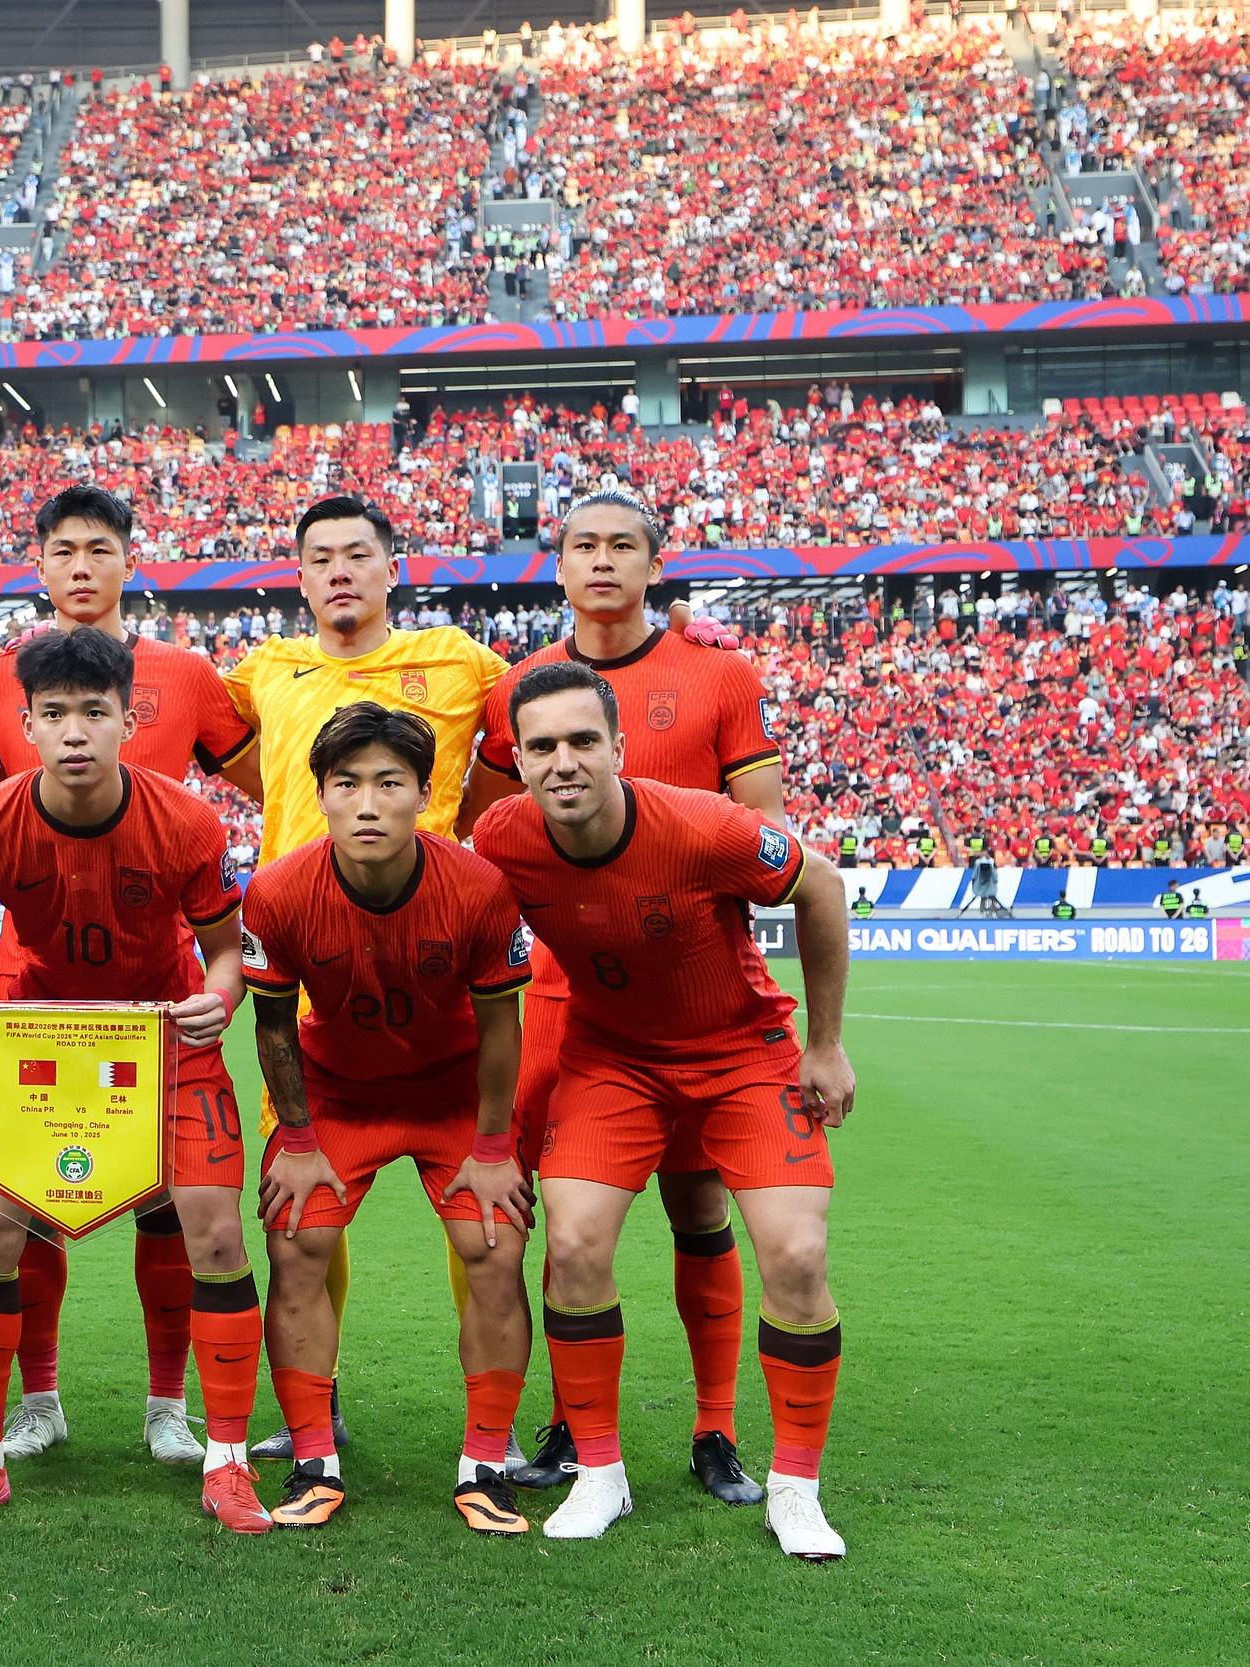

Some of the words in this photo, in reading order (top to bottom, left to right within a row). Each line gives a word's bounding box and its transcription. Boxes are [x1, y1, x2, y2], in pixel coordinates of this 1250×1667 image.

[650, 692, 675, 701] CFA
[61, 920, 114, 968] 10
[848, 928, 912, 951] SIAN
[1091, 927, 1145, 953] ROAD
[1150, 927, 1175, 953] TO
[1180, 926, 1209, 953] 26
[591, 950, 628, 990] 8
[350, 987, 414, 1032] 20
[105, 1107, 134, 1115] Bahrain
[110, 1095, 127, 1104] 巴林
[778, 1085, 815, 1140] 8
[89, 1121, 110, 1129] China
[192, 1088, 241, 1142] 10
[46, 1189, 103, 1200] 中国足球协会
